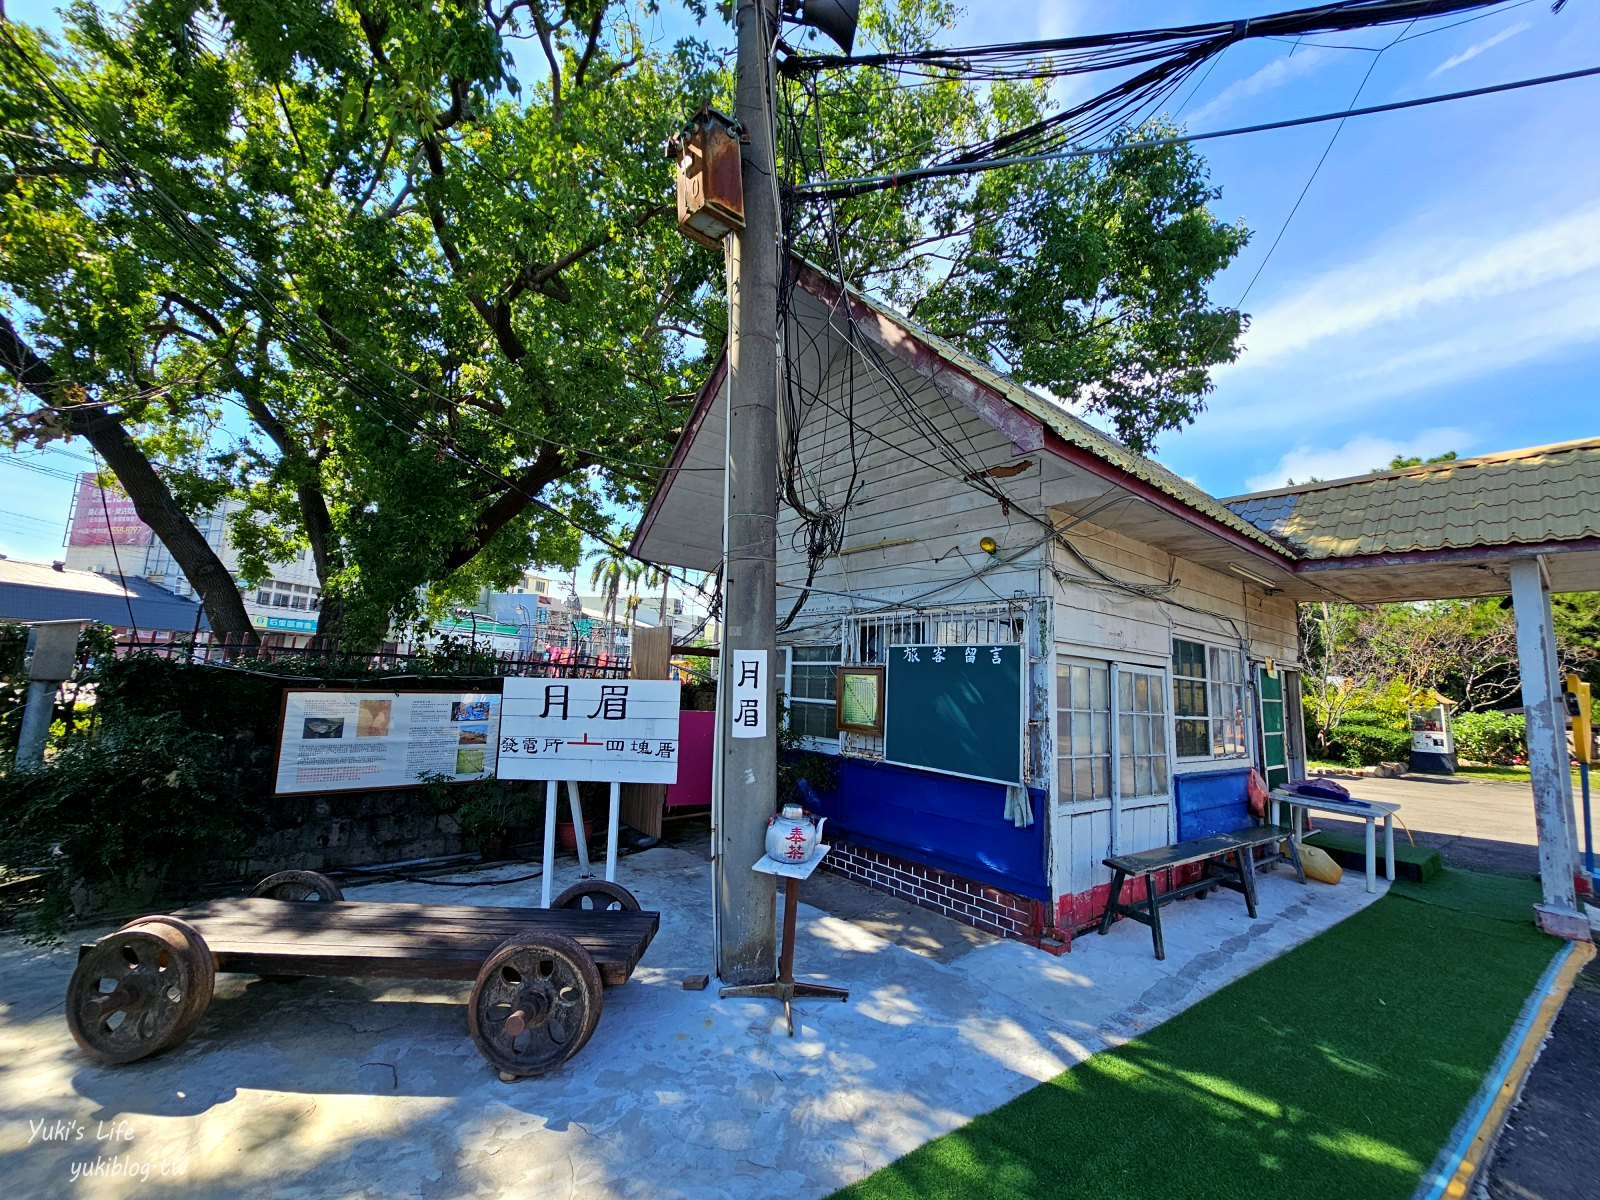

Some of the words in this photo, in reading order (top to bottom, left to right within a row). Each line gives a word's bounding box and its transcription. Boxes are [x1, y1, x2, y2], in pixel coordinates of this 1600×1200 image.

[902, 646, 1003, 665] 旅客留言
[539, 685, 629, 721] 月眉
[734, 660, 759, 727] 月眉
[500, 737, 564, 754] 發電所
[606, 740, 676, 759] 四塊厝
[784, 826, 807, 860] 奉茶
